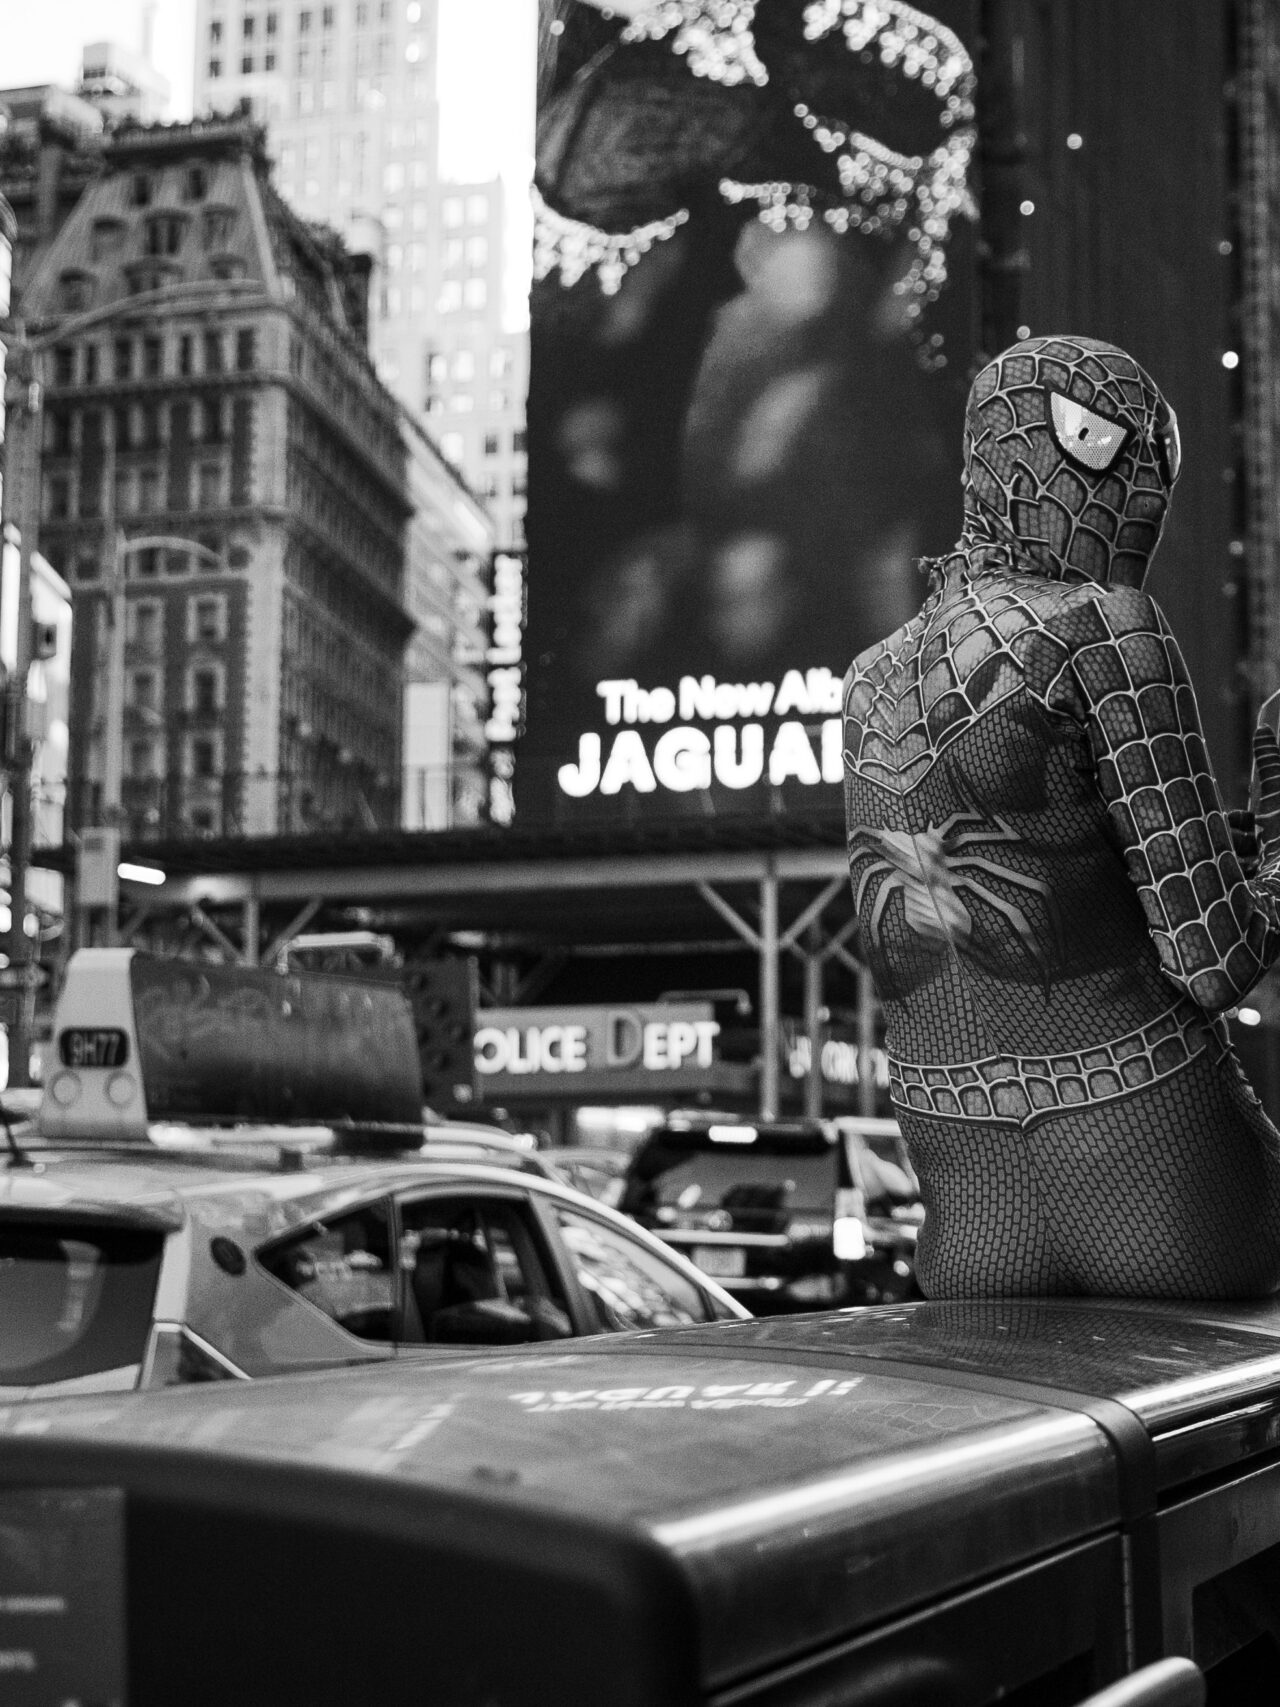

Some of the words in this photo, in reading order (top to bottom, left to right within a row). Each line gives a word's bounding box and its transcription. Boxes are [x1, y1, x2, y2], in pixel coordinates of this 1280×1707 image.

[597, 679, 675, 724] The
[679, 675, 775, 719] New
[774, 667, 844, 715] Alb
[474, 1027, 587, 1073] OLICE
[608, 1009, 720, 1069] DEPT
